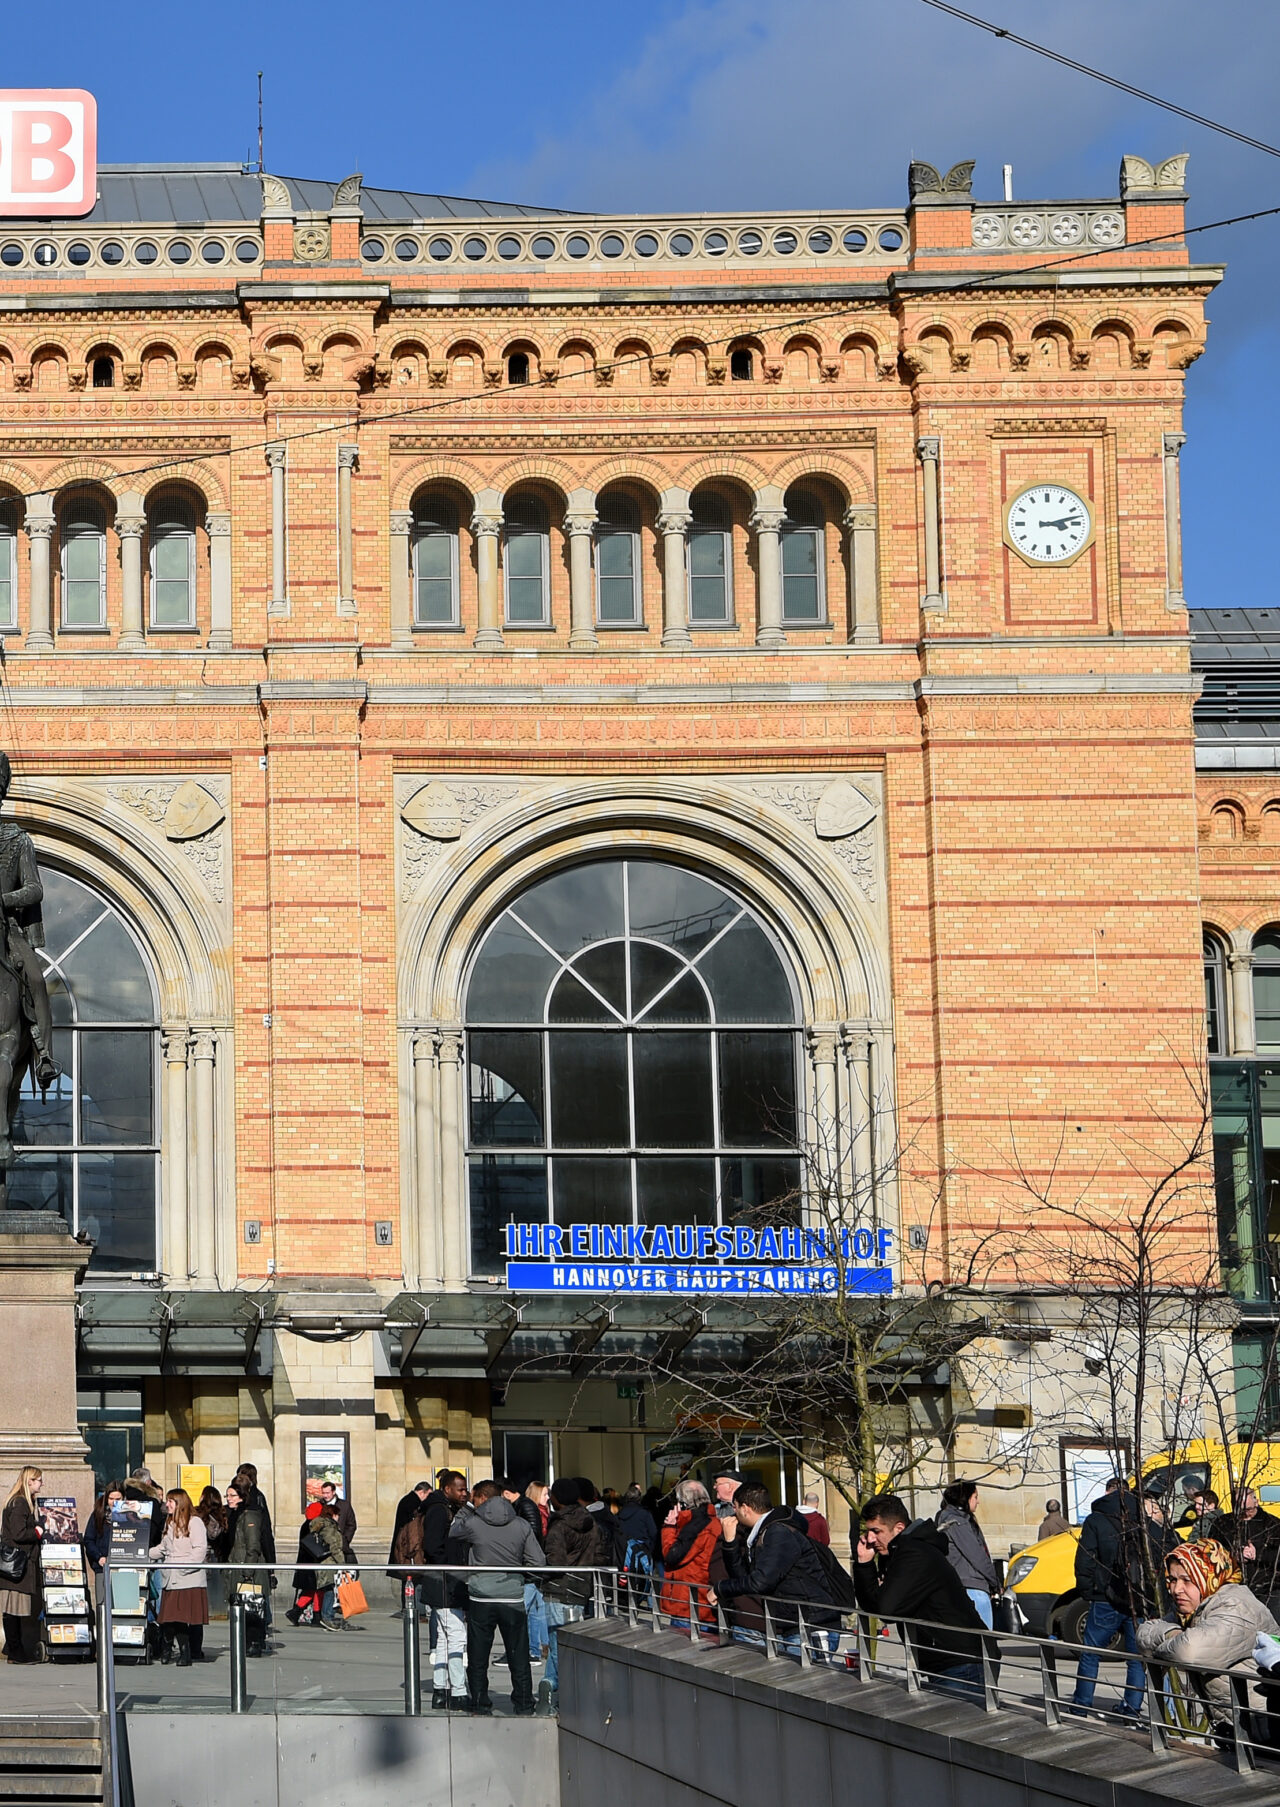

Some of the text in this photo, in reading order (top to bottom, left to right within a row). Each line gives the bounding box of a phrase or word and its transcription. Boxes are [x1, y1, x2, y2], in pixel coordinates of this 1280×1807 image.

[506, 1223, 894, 1261] IHR EINKAUFSBAHNHOF
[552, 1267, 667, 1287] HANNOVER
